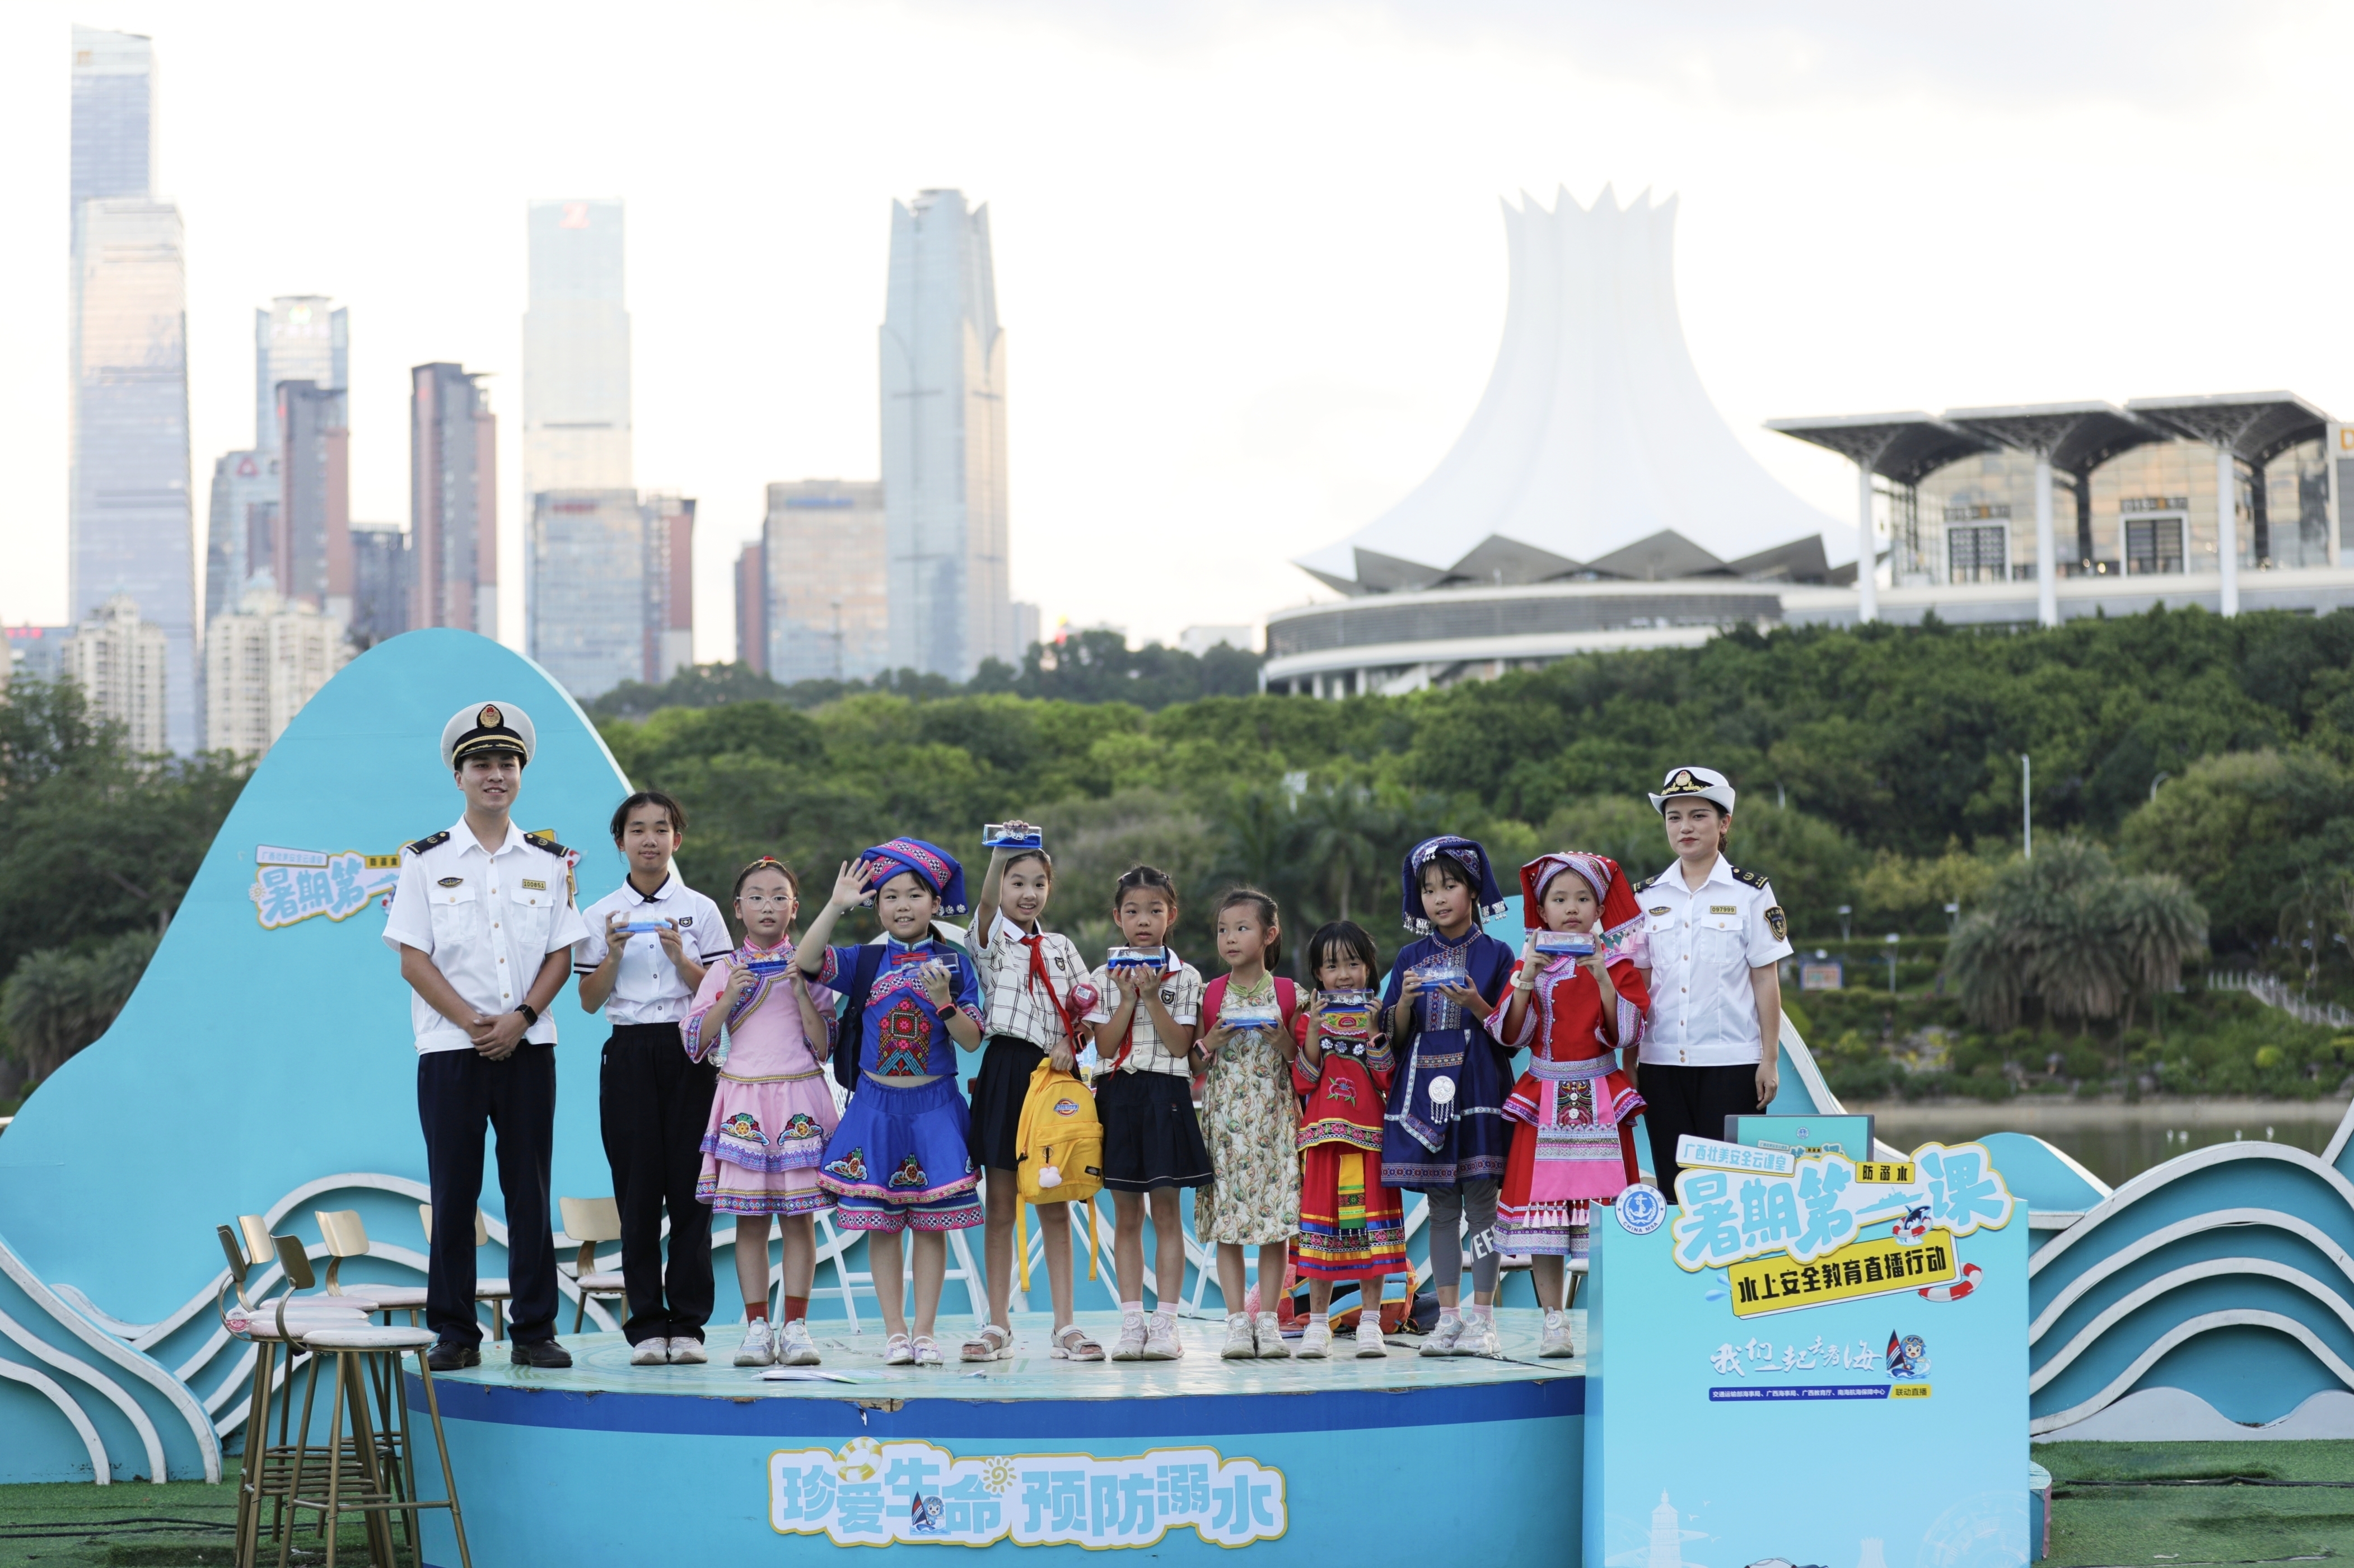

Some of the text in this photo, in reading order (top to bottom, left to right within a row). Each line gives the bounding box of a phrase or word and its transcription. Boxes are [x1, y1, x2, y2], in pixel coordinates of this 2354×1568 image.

[1683, 1143, 1787, 1172] 广西壮美安全云课堂
[1862, 1165, 1908, 1182] 防溺水
[1623, 1221, 1659, 1233] CHINA MSA
[1738, 1246, 1947, 1304] 水上安全教育直播行动
[1895, 1388, 1928, 1397] 联动直播
